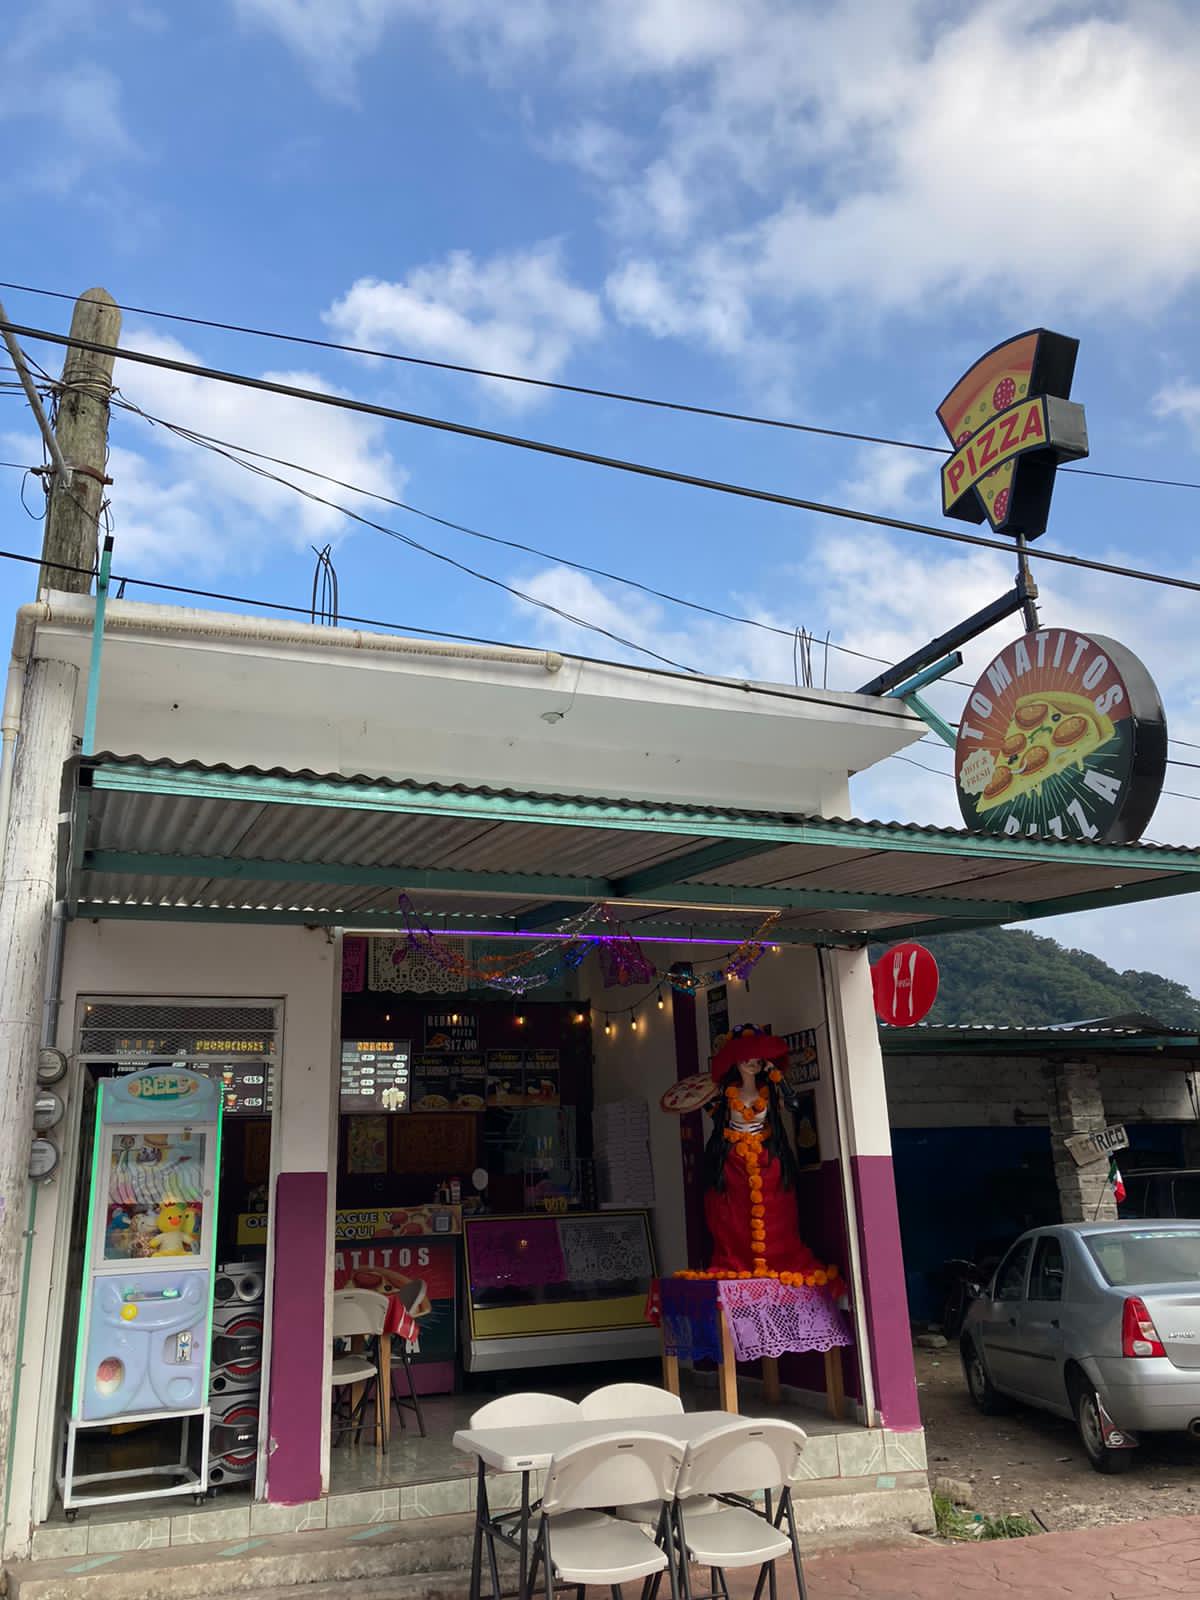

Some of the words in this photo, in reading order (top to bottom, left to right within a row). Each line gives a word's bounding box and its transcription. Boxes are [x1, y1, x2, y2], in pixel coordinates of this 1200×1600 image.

[946, 404, 1043, 495] PIZZA
[961, 631, 1124, 741] TOMATITOS
[335, 1213, 378, 1224] AGUE
[383, 1212, 393, 1224] Y
[335, 1226, 375, 1239] AQUI
[335, 1247, 431, 1271] ATITOS
